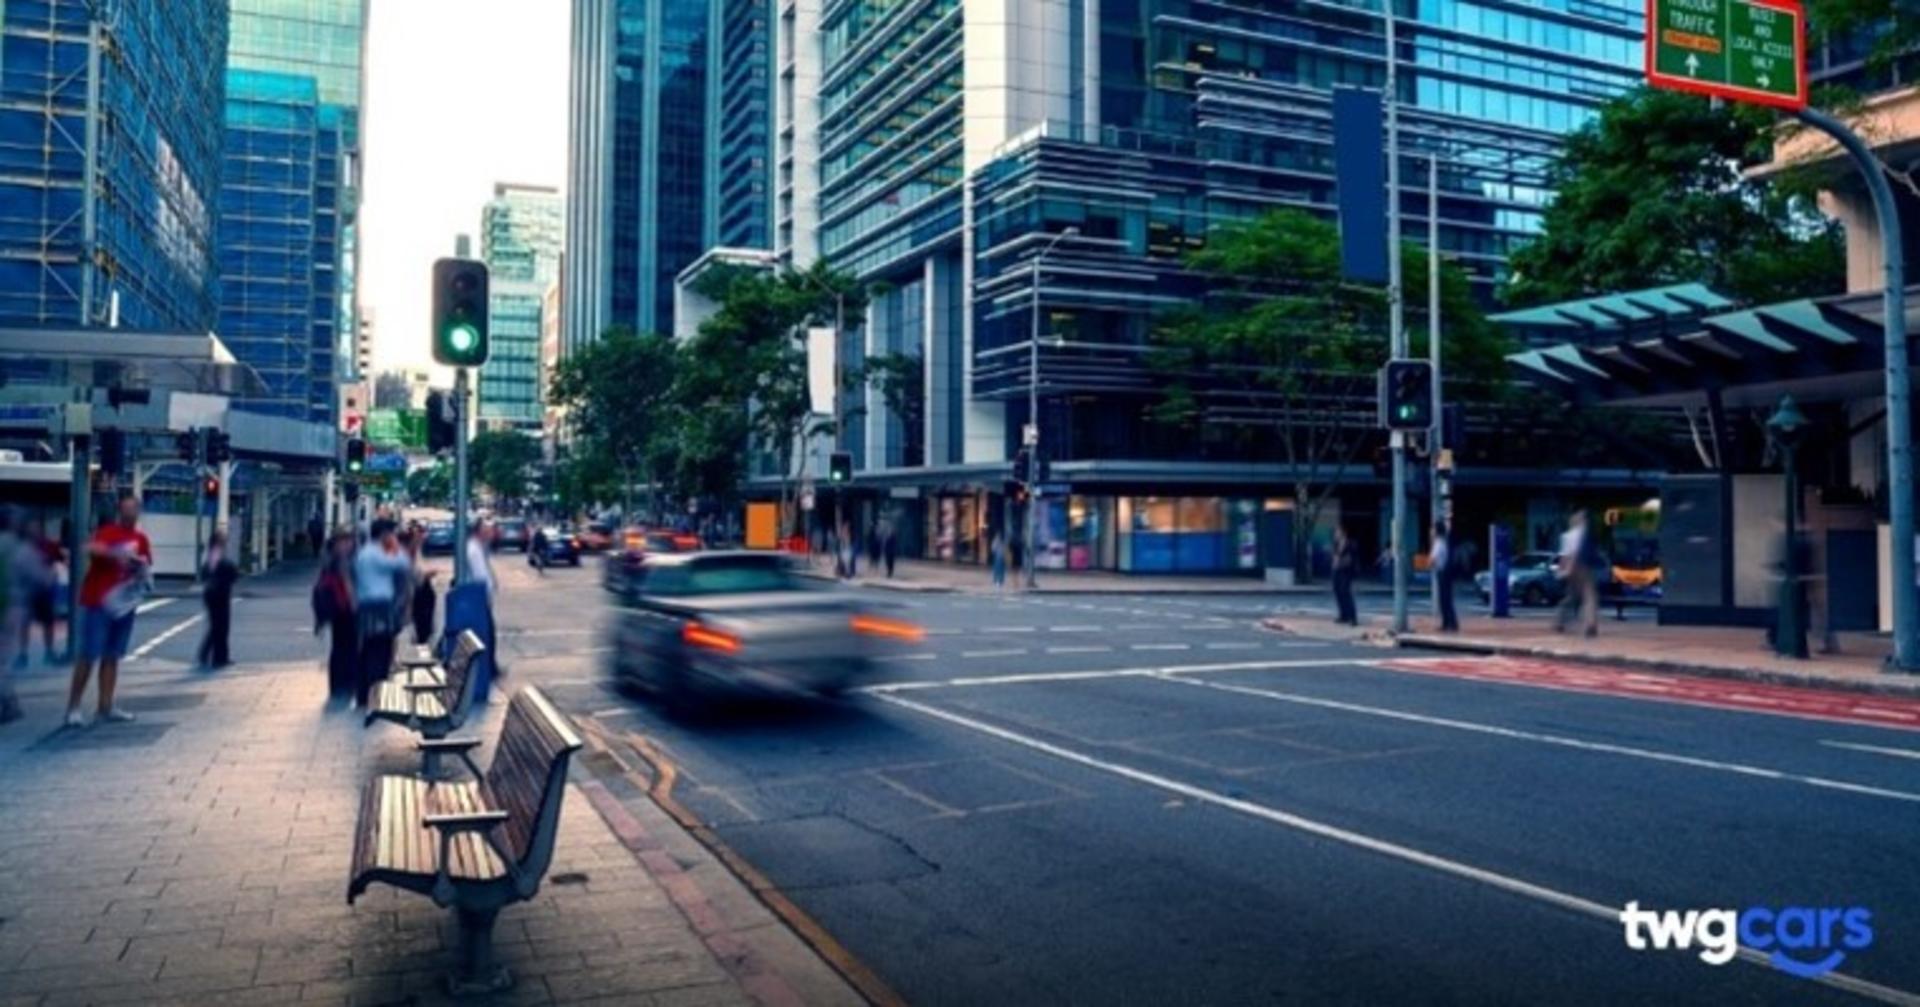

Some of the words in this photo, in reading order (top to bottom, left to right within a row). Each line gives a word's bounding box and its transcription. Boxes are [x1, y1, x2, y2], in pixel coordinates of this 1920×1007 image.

[1670, 10, 1715, 36] TRAFFIC
[1754, 25, 1772, 39] AND
[1732, 36, 1757, 51] LOCAL
[1762, 42, 1793, 60] ACCESS
[1752, 55, 1775, 70] ONLY
